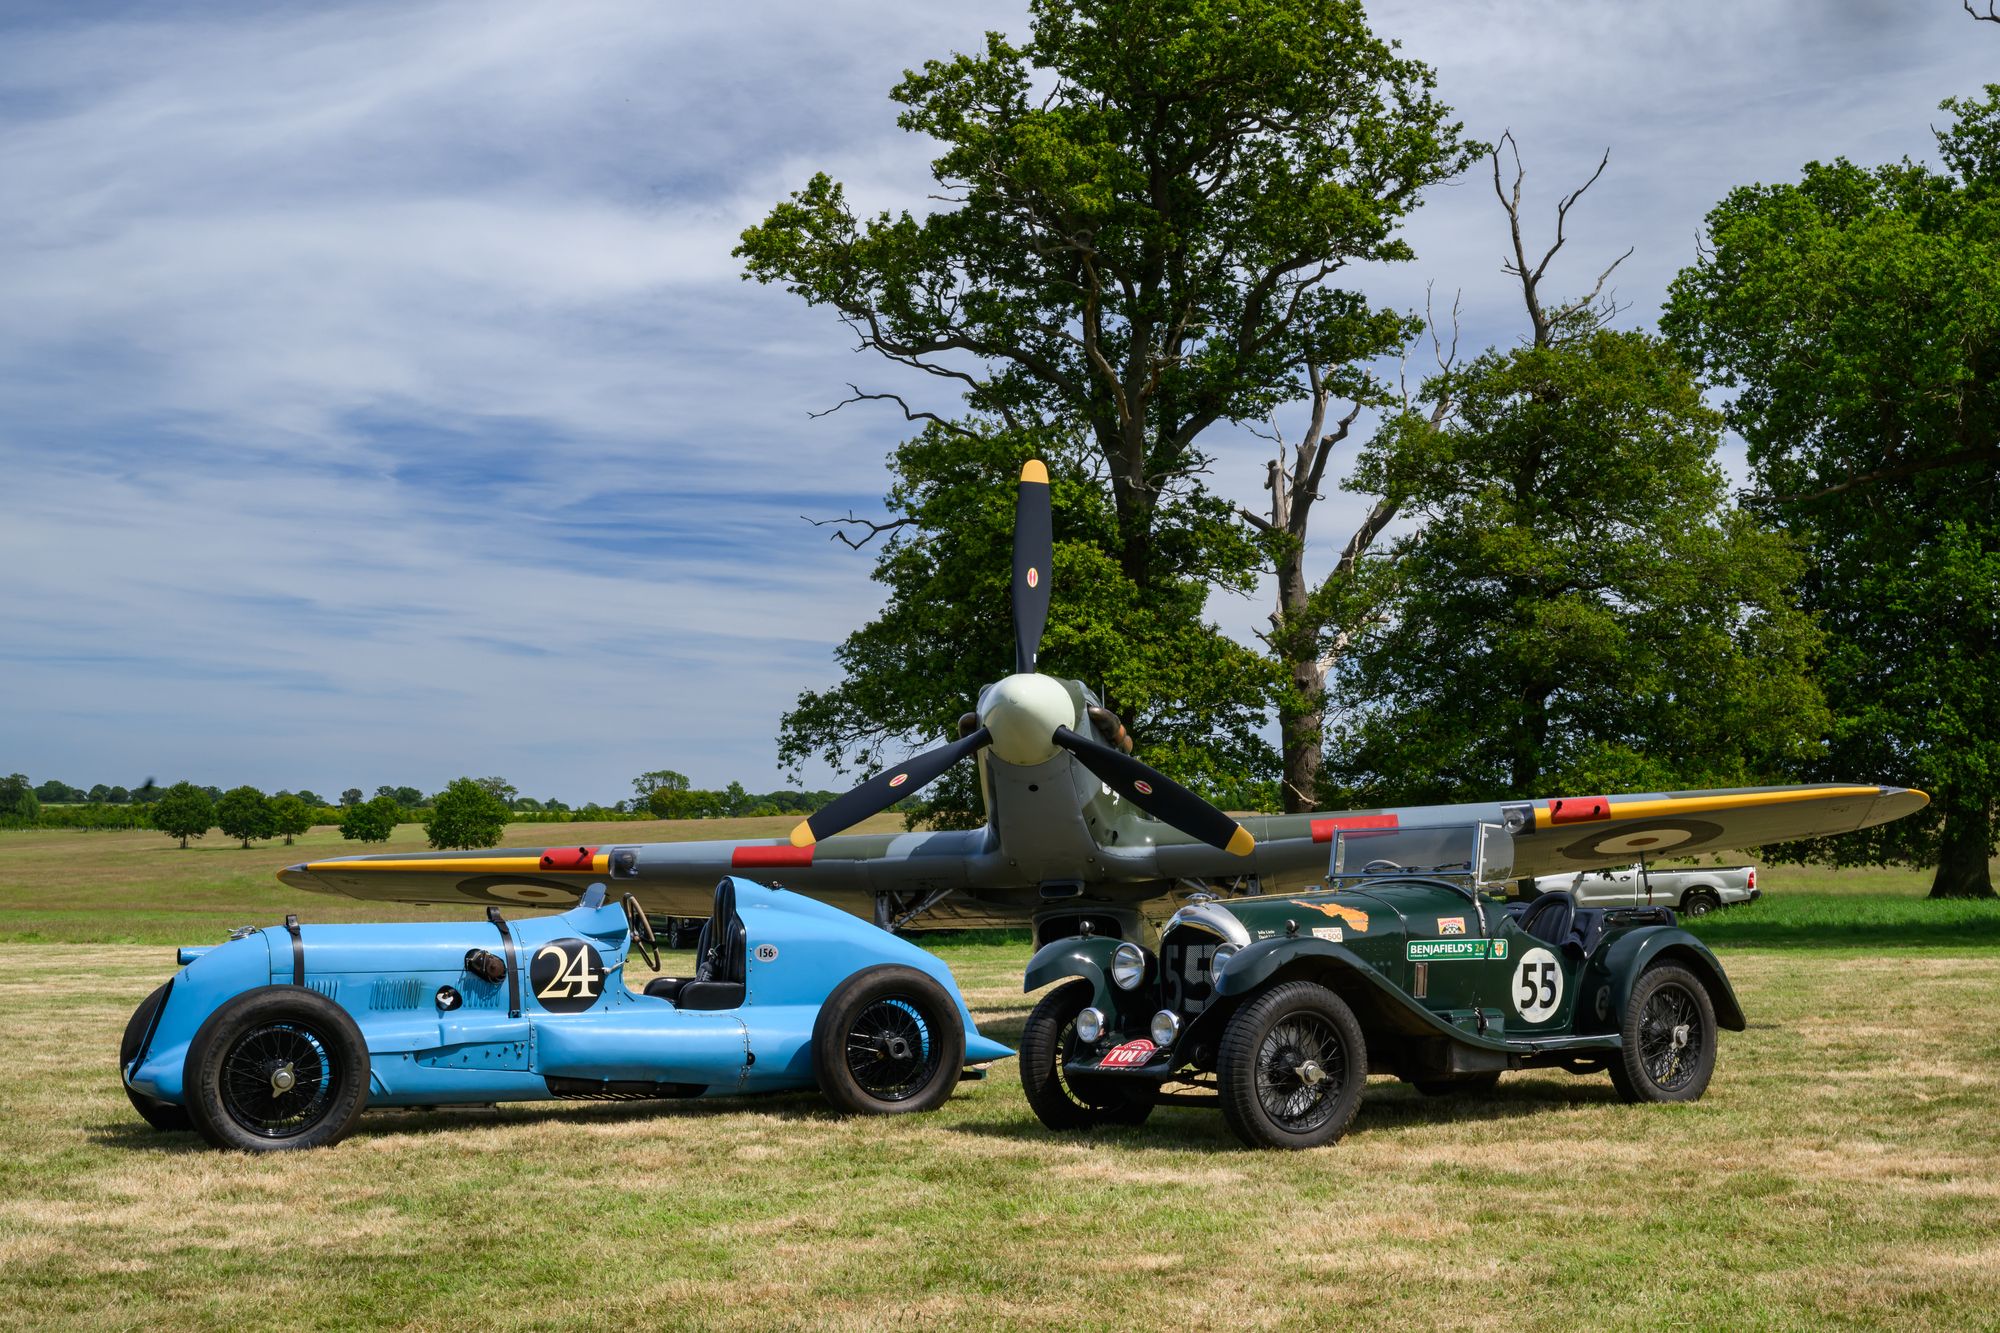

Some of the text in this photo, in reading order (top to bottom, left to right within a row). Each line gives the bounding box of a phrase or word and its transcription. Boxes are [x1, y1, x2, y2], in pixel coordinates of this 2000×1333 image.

[759, 948, 774, 958] 156
[1410, 943, 1485, 955] BENJAFIELD'S 24
[537, 945, 599, 998] 24
[1520, 962, 1557, 1009] 55
[1108, 1050, 1153, 1062] TOUR
